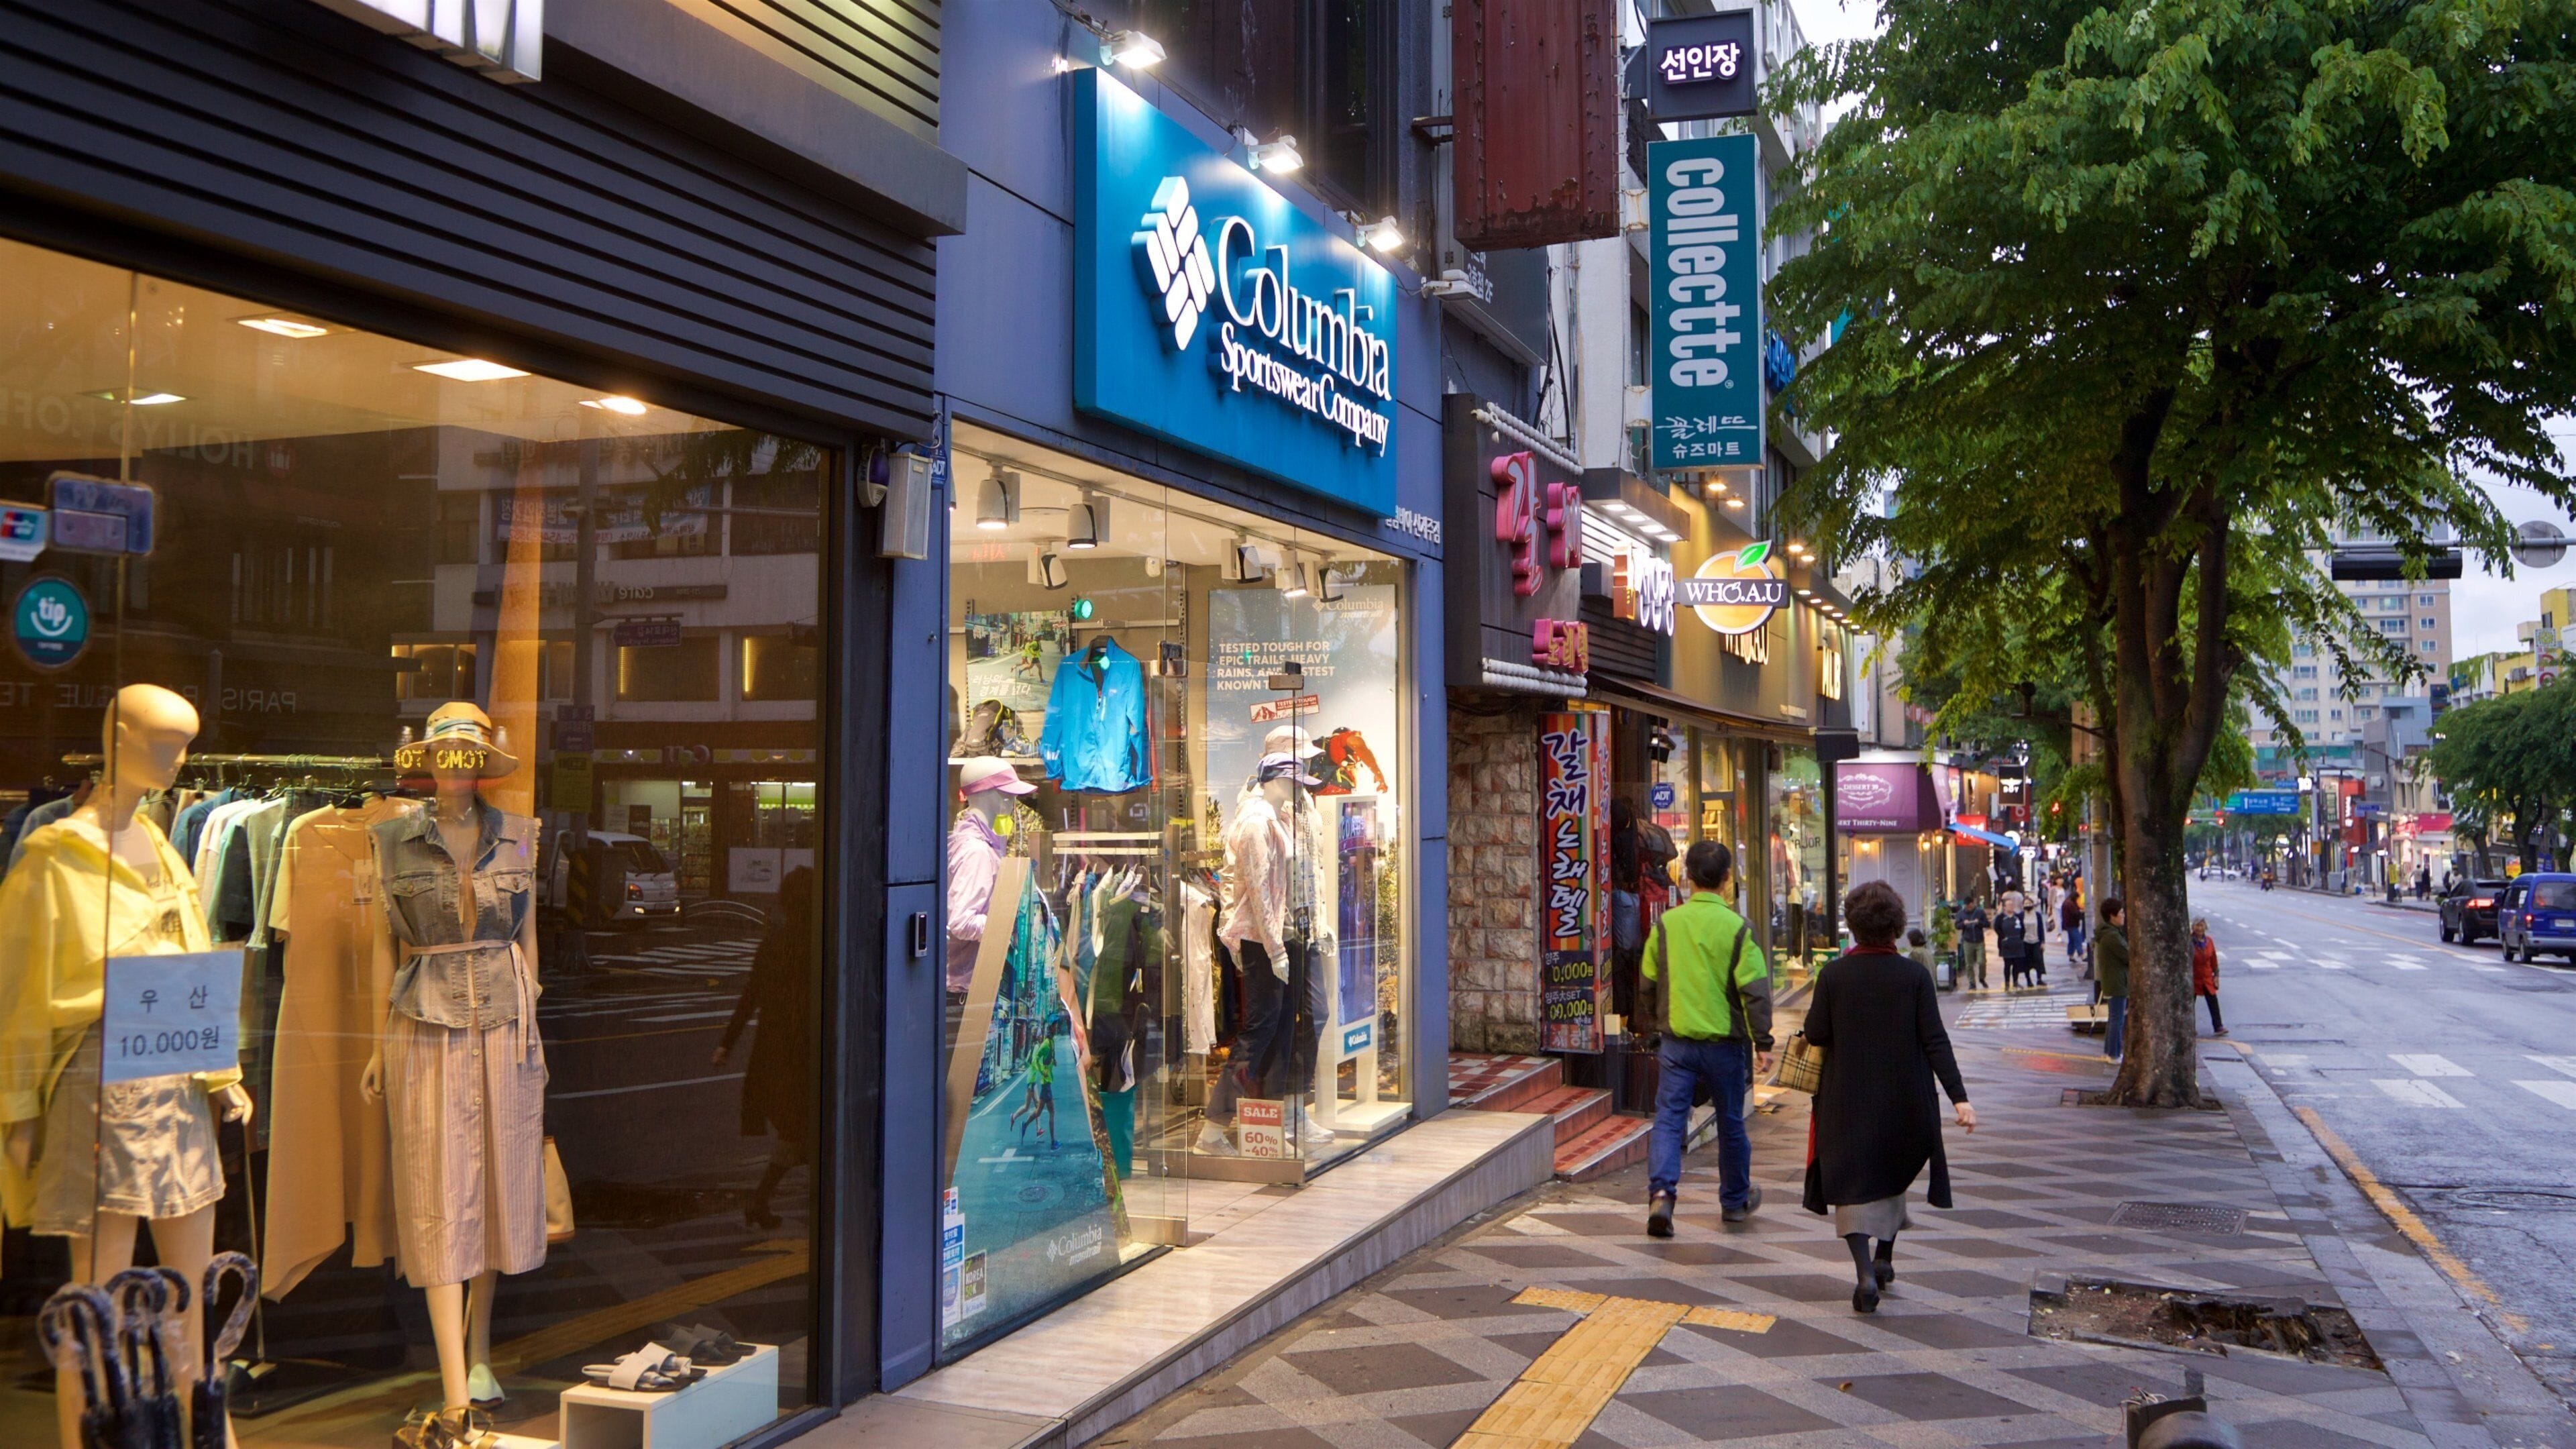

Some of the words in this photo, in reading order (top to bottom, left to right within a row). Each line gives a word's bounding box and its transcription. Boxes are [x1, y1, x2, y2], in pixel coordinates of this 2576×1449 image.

[1660, 42, 1741, 82] 선인장
[1666, 157, 1741, 389] collectte
[1216, 215, 1393, 402] Columbia
[1220, 321, 1320, 411] Sportswear
[1319, 374, 1390, 458] Company
[1672, 440, 1741, 459] 슈즈마트
[1684, 580, 1784, 604] WHO.A.U
[38, 596, 66, 628] tip
[1326, 597, 1384, 611] Columbia
[1219, 643, 1260, 653] TESTED
[1262, 641, 1303, 652] TOUGH
[1305, 641, 1330, 651] FOR
[1219, 655, 1244, 665] EPIC
[1291, 653, 1330, 664] HEAVY
[1217, 667, 1254, 679] RAINS,
[1821, 645, 1841, 701] MLB
[1217, 680, 1261, 691] KNOWN
[1654, 790, 1671, 802] ADT
[1791, 837, 1821, 850] AJOR
[119, 1025, 221, 1060] 10.000원
[1243, 1107, 1279, 1119] SALE
[1244, 1132, 1279, 1146] 60%
[1058, 1224, 1102, 1256] Columbia
[965, 1267, 984, 1285] KOREA
[965, 1284, 977, 1299] 50K
